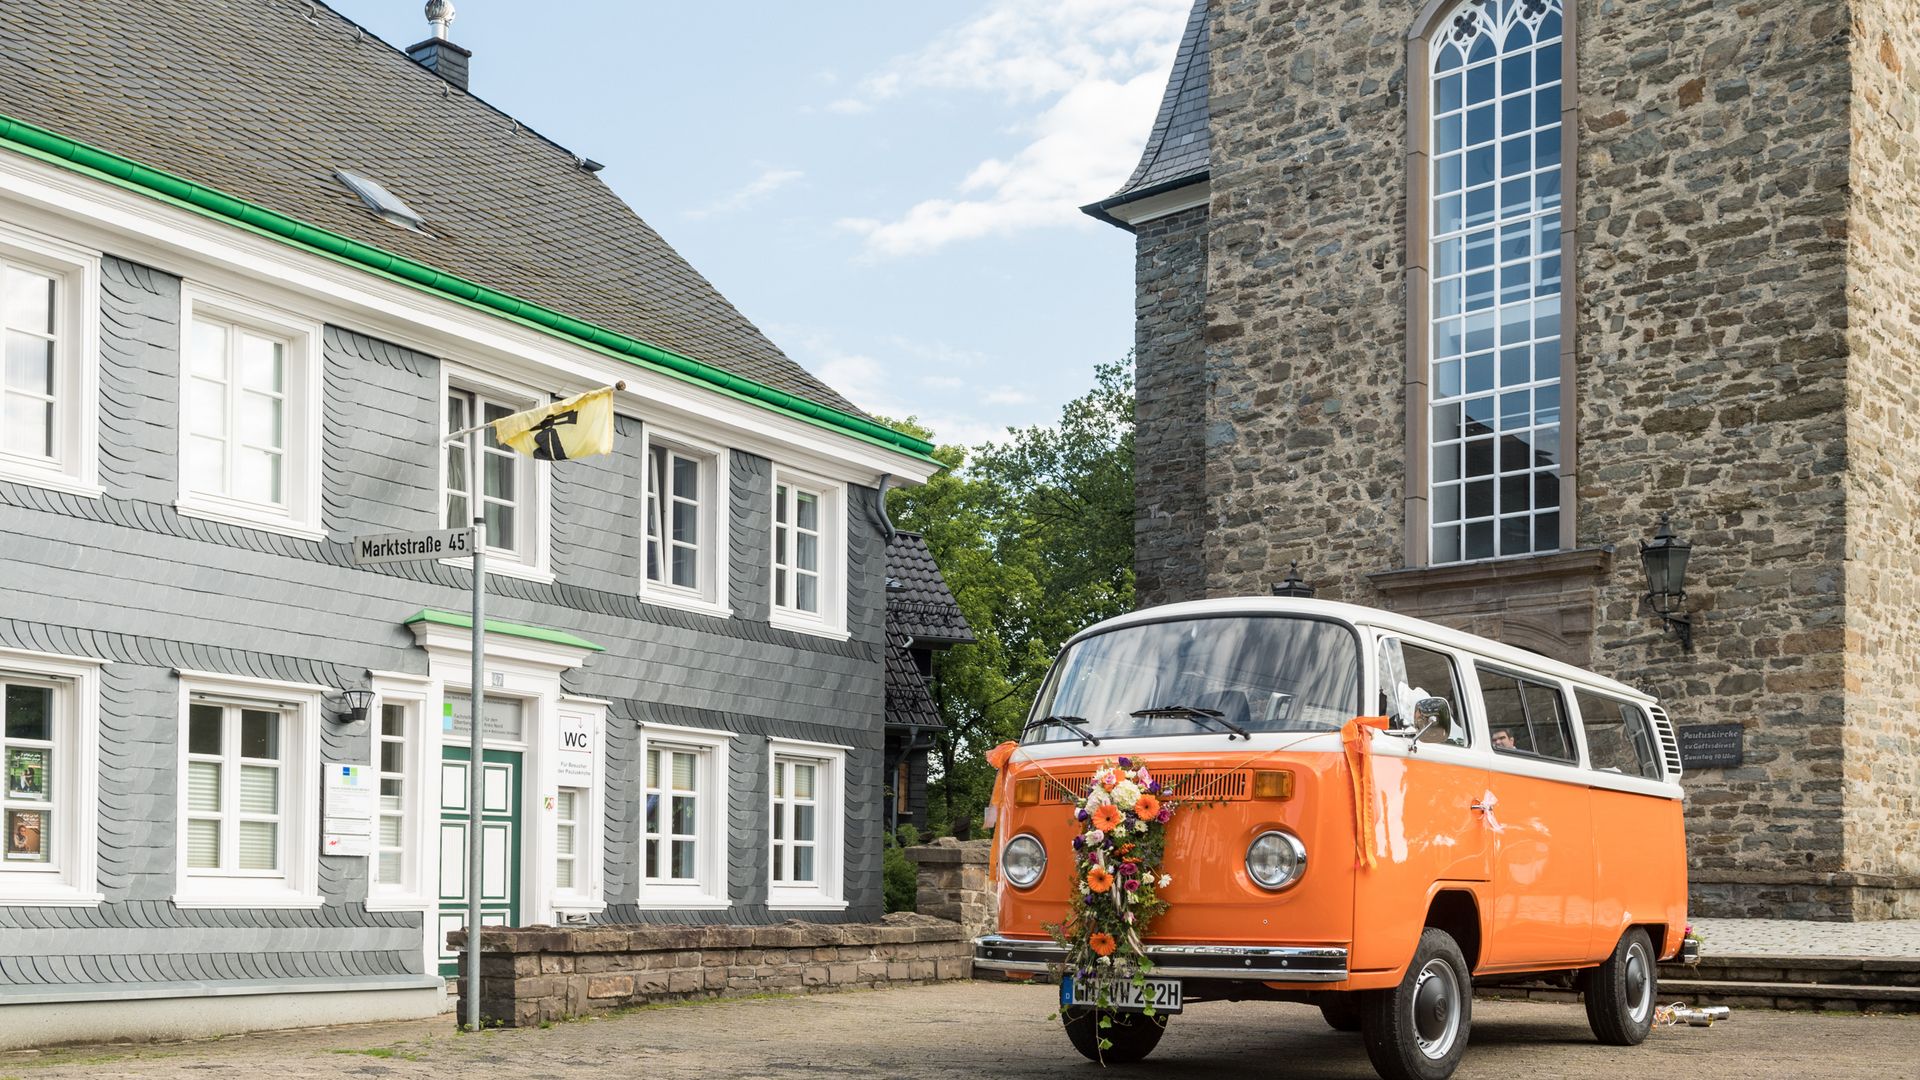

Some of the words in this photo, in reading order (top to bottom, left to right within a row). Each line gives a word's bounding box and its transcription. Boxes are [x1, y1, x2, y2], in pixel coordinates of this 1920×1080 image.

[362, 535, 442, 557] Marktstraße
[449, 533, 465, 551] 45
[564, 731, 587, 748] WC
[1683, 730, 1738, 739] Pauluskirche
[1684, 753, 1713, 761] Sonntag
